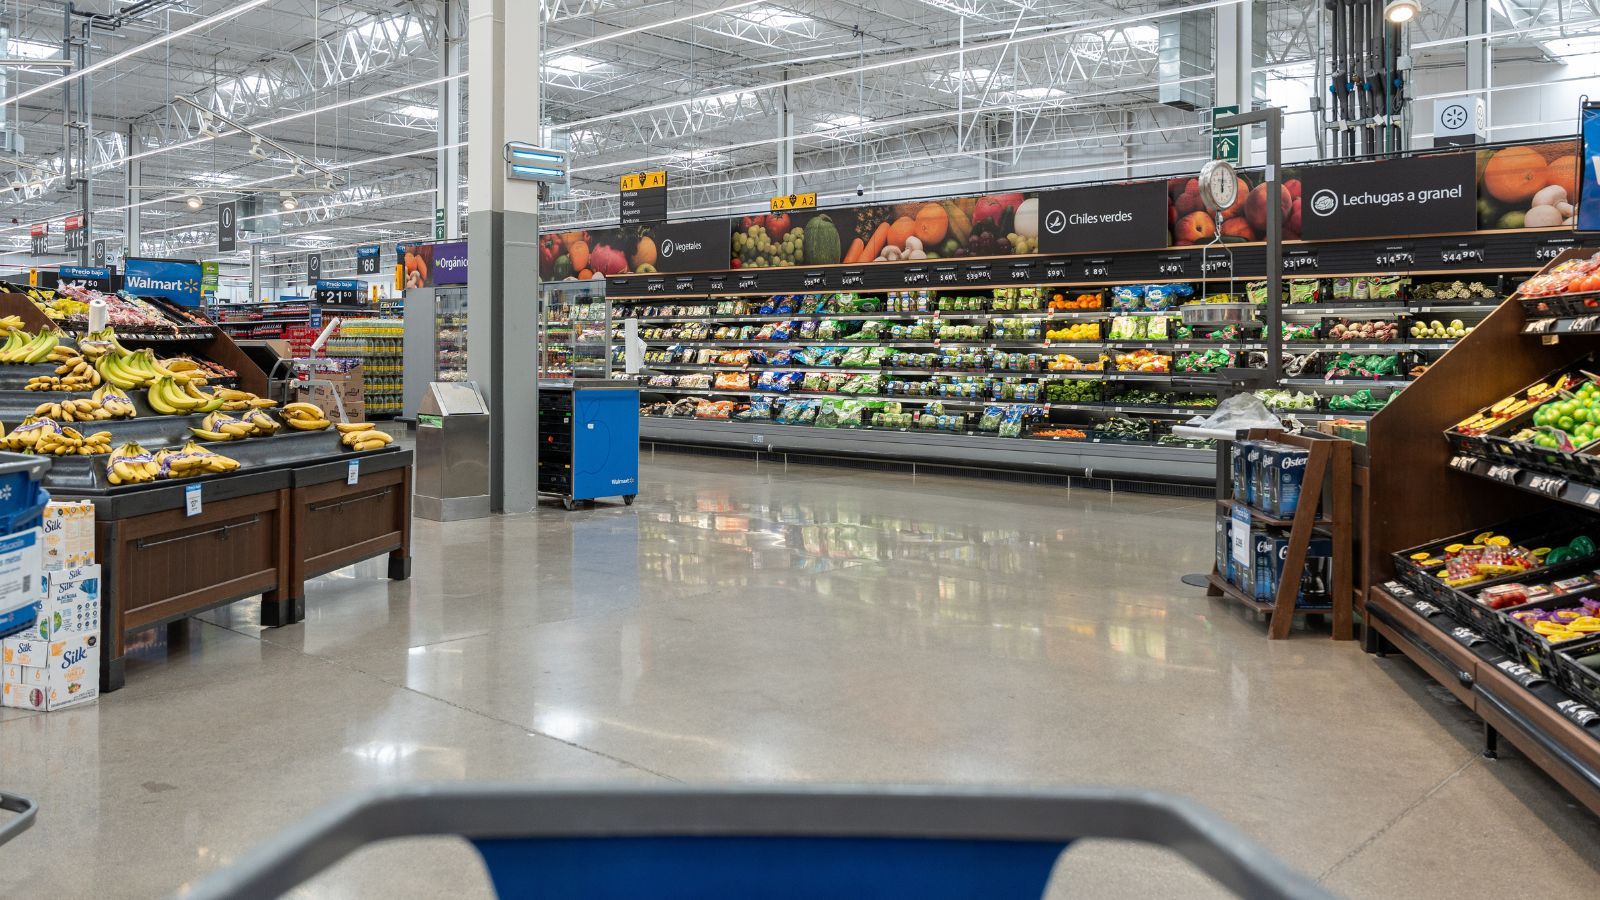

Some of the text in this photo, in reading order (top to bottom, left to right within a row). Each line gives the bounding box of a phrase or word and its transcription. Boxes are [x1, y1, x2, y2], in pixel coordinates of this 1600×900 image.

[1343, 184, 1462, 206] Lechugas a granel
[1070, 210, 1132, 225] Chiles verdes
[675, 241, 702, 252] Vegetales
[127, 276, 182, 290] Walmart
[1282, 457, 1308, 470] Oster
[44, 519, 62, 534] Silk
[69, 569, 82, 580] Silk
[58, 582, 74, 594] Silk
[18, 642, 32, 654] Silk
[62, 646, 88, 669] Silk
